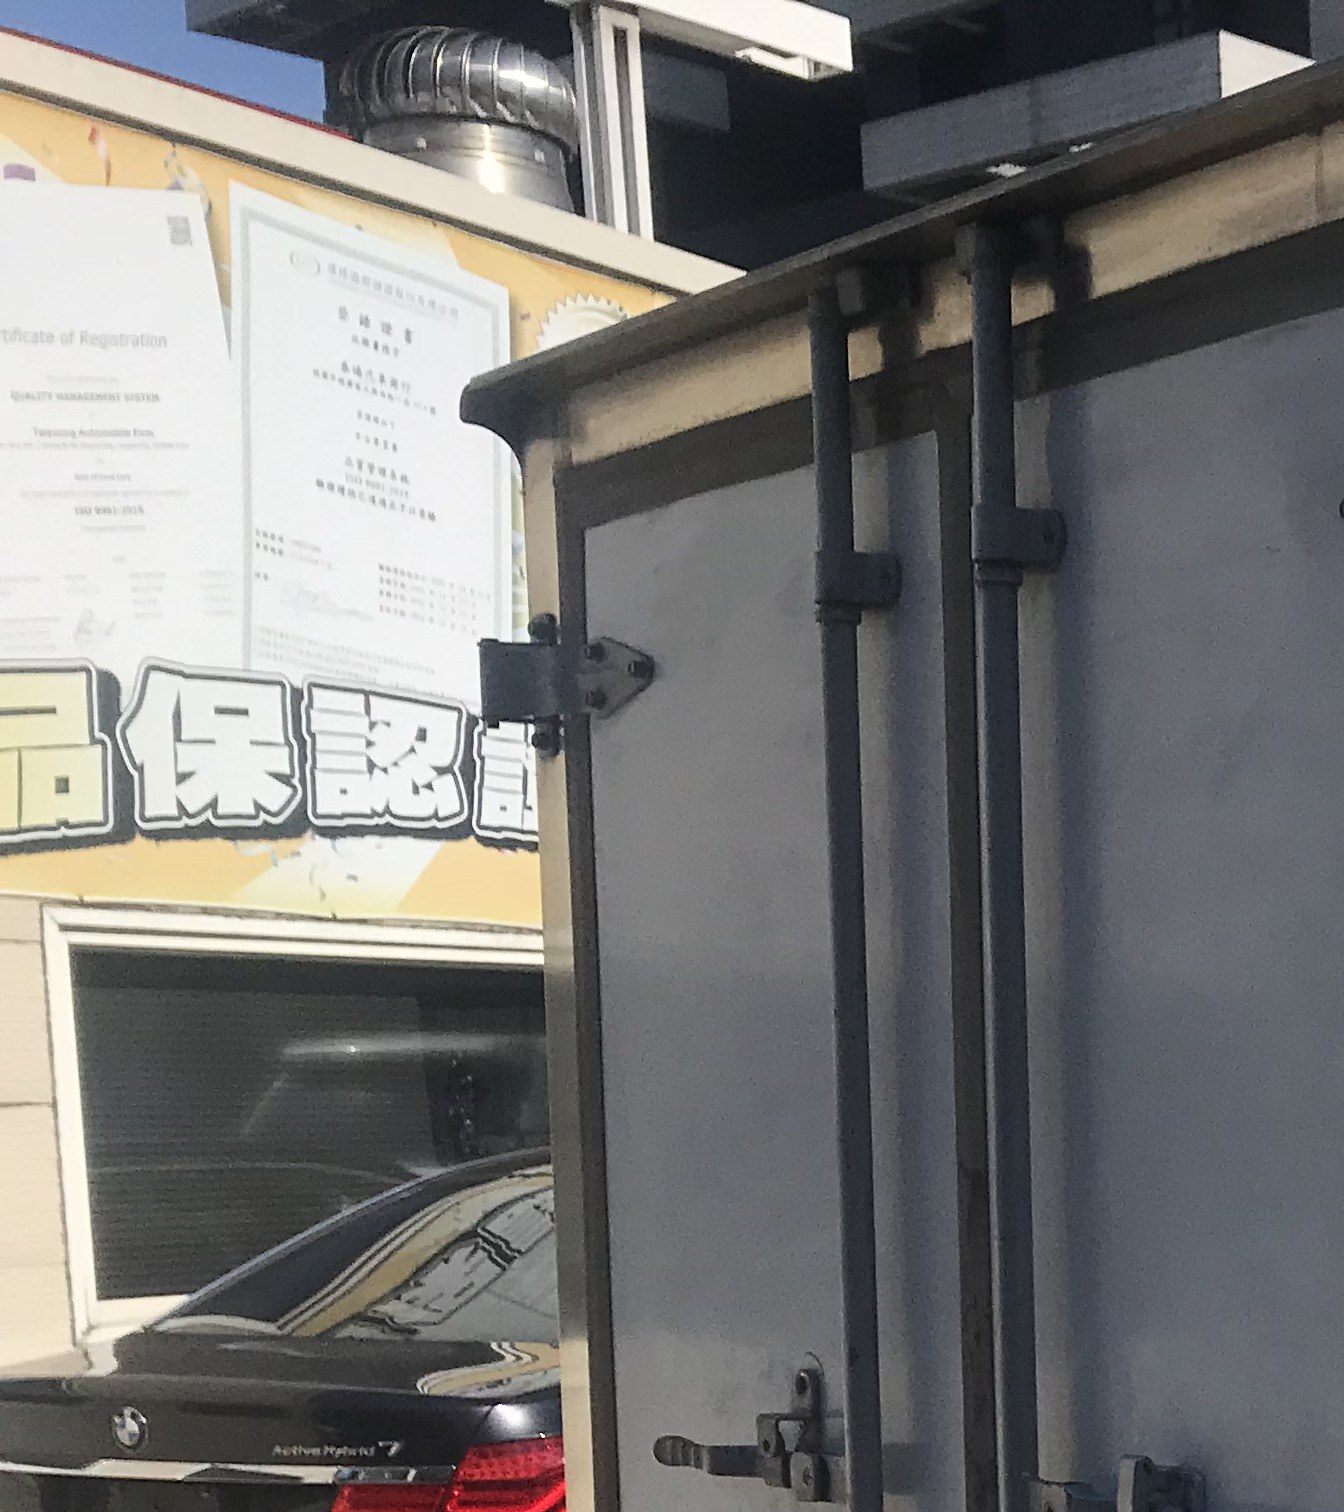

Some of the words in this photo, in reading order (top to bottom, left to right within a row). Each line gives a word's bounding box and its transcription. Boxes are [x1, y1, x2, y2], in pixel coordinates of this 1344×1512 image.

[0, 326, 55, 345] tificate
[60, 329, 75, 346] of
[79, 329, 168, 351] Registration
[10, 390, 53, 403] QUALITY
[55, 391, 121, 403] MANAGEMENT
